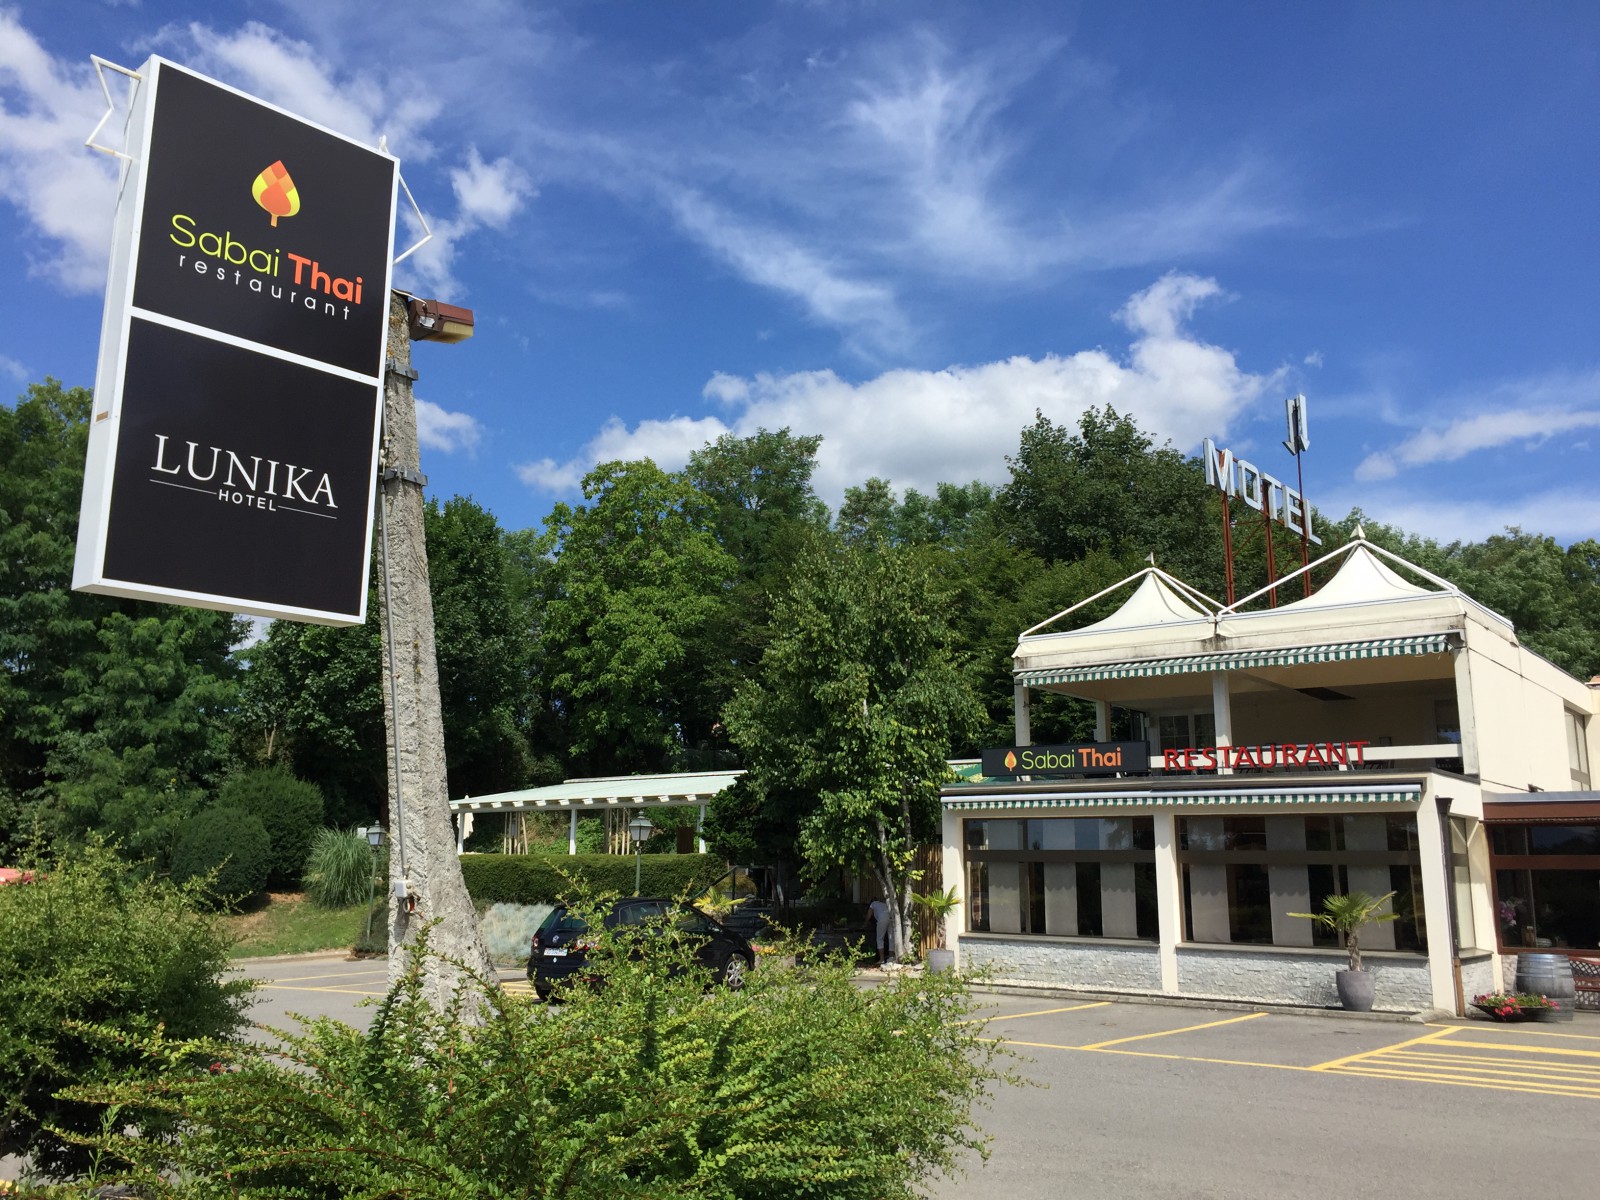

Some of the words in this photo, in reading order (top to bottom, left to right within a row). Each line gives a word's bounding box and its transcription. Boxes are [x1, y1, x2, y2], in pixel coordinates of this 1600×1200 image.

[169, 214, 280, 277] Sabai
[287, 252, 363, 305] Thai
[179, 254, 350, 321] restaurant
[151, 433, 339, 509] LUNIKA
[218, 489, 277, 512] HOTEL
[1203, 437, 1323, 546] MOTEL
[1021, 749, 1075, 770] Sabai
[1078, 746, 1122, 768] Thai
[1163, 741, 1371, 772] RESTAURANT
